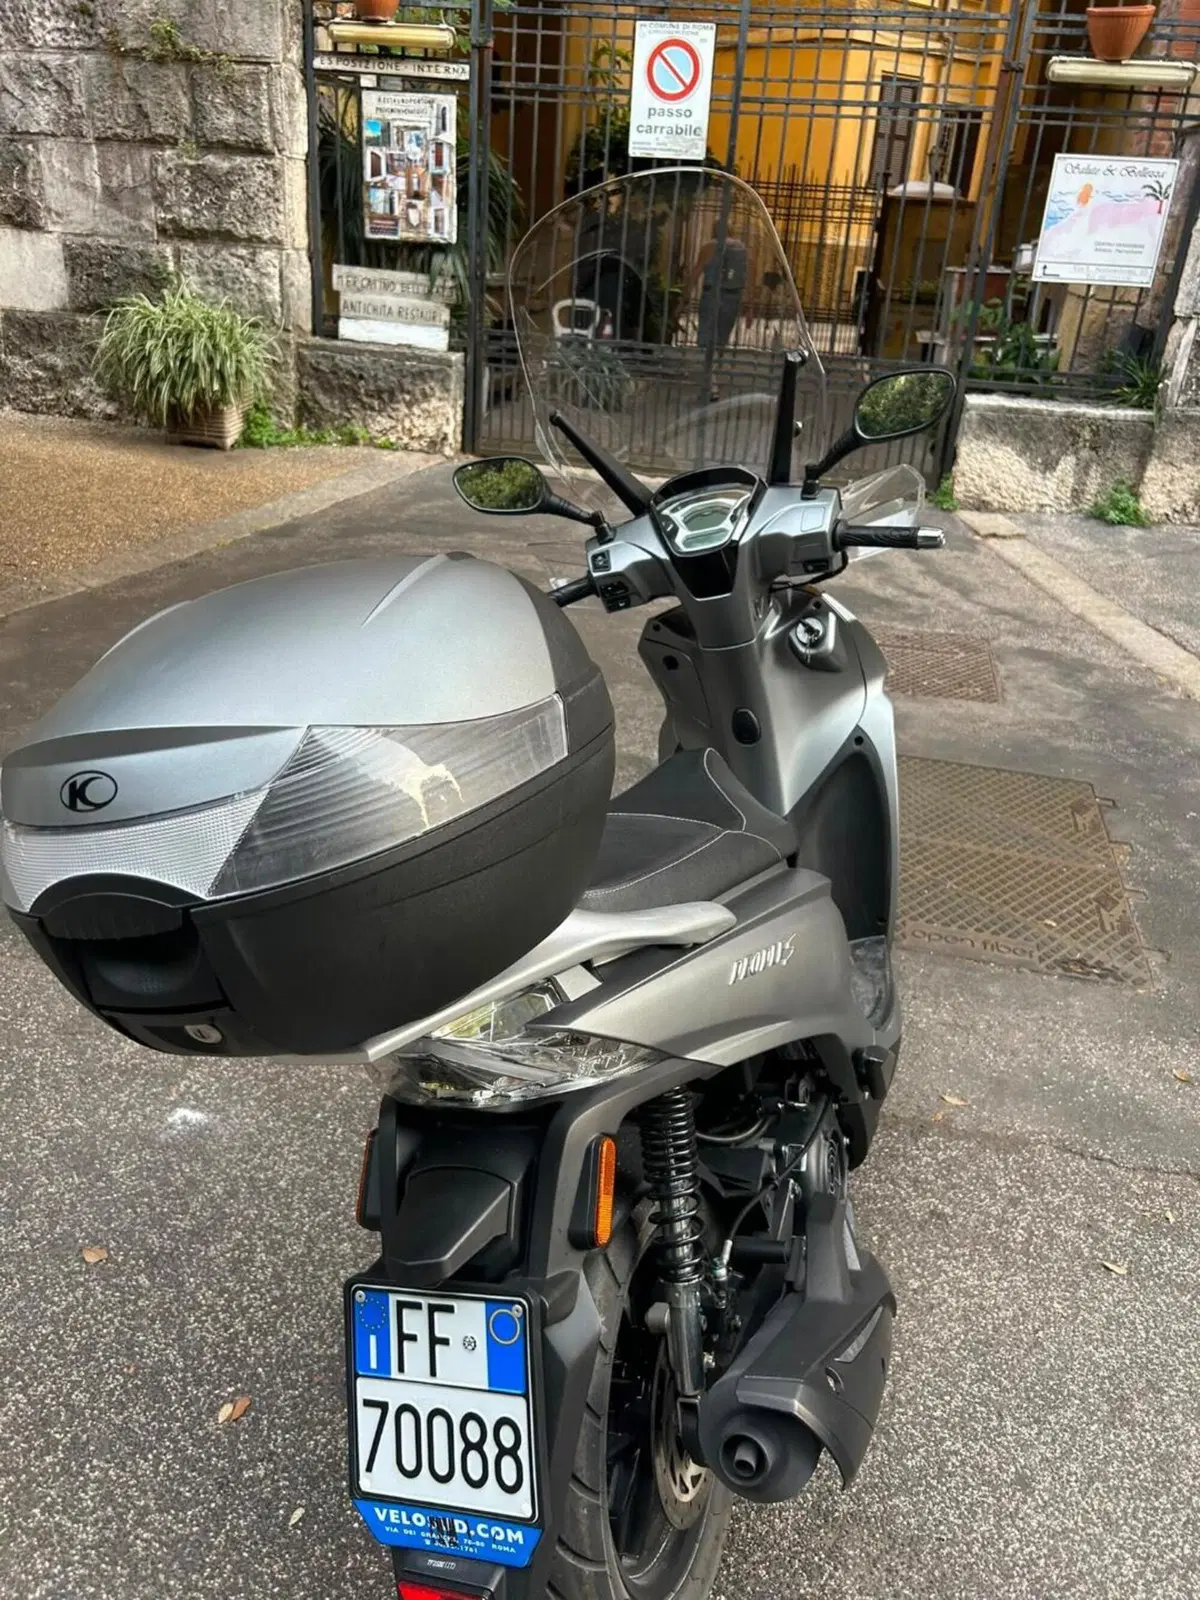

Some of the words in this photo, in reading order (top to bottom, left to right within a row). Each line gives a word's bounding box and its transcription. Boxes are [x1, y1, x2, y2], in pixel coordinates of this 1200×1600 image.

[648, 22, 680, 30] COMUNE
[319, 56, 401, 71] ESPOSIZIONE
[413, 63, 468, 75] INTERNA
[647, 107, 693, 119] passo
[636, 123, 702, 137] carrabile
[341, 299, 394, 316] ANTICHITA
[396, 1299, 455, 1377] FF
[362, 1398, 524, 1494] 70088
[385, 1525, 399, 1533] VIA
[491, 1543, 516, 1554] ROMA
